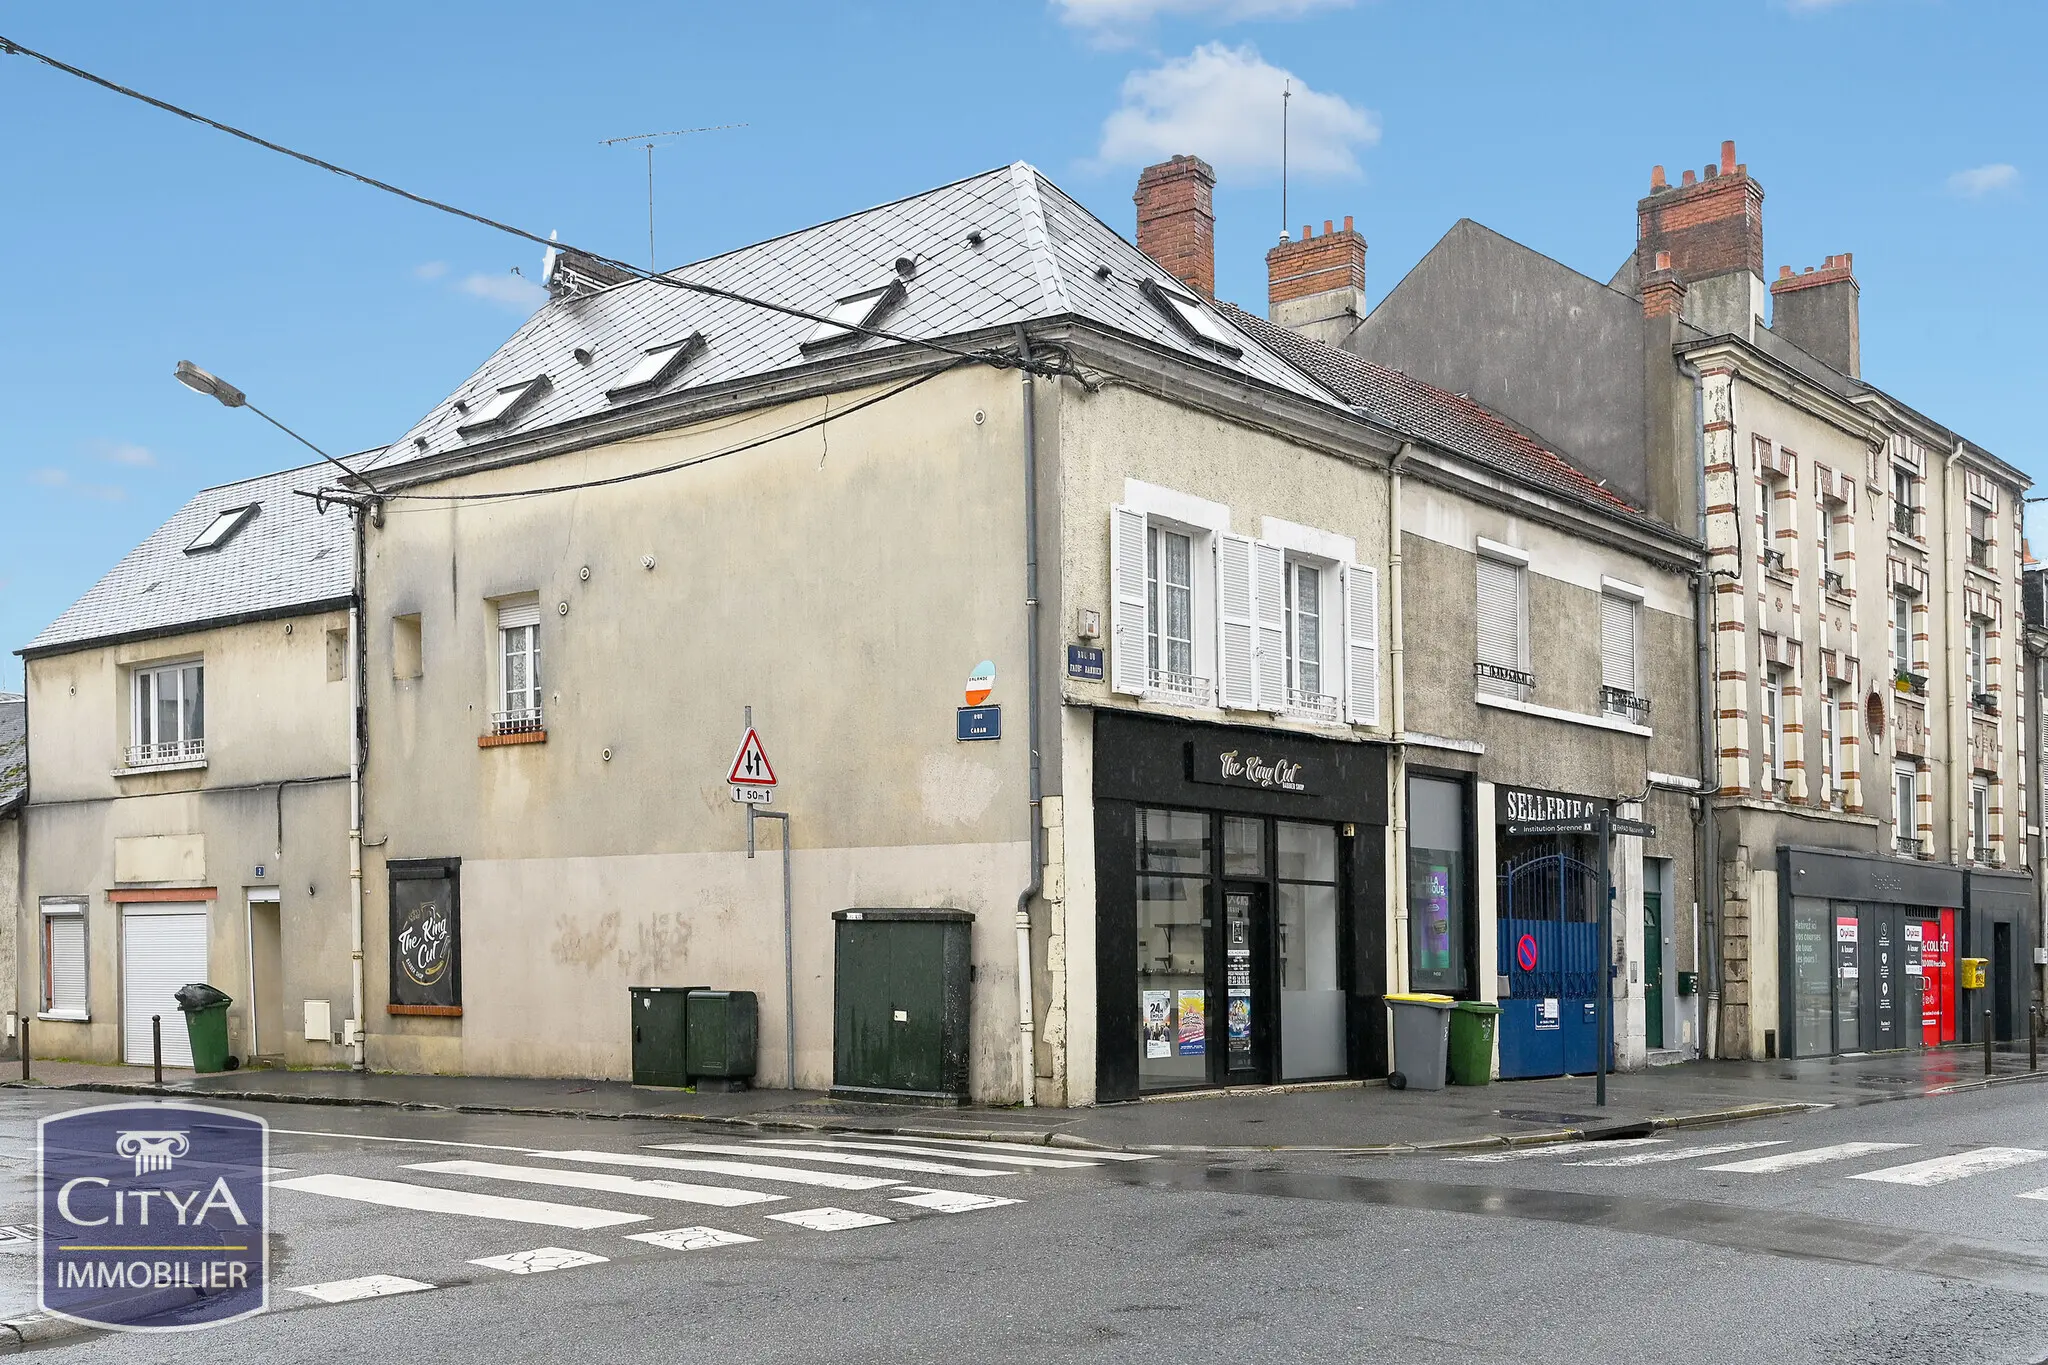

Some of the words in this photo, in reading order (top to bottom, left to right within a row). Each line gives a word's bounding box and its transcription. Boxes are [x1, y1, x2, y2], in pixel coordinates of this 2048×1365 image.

[1220, 750, 1245, 778] The
[1246, 756, 1274, 787] King
[1274, 759, 1302, 784] Cut
[1507, 791, 1582, 822] SELLERIE
[398, 927, 421, 955] The
[422, 917, 448, 942] King
[1927, 940, 1949, 952] COLLECT
[418, 940, 440, 968] Cut
